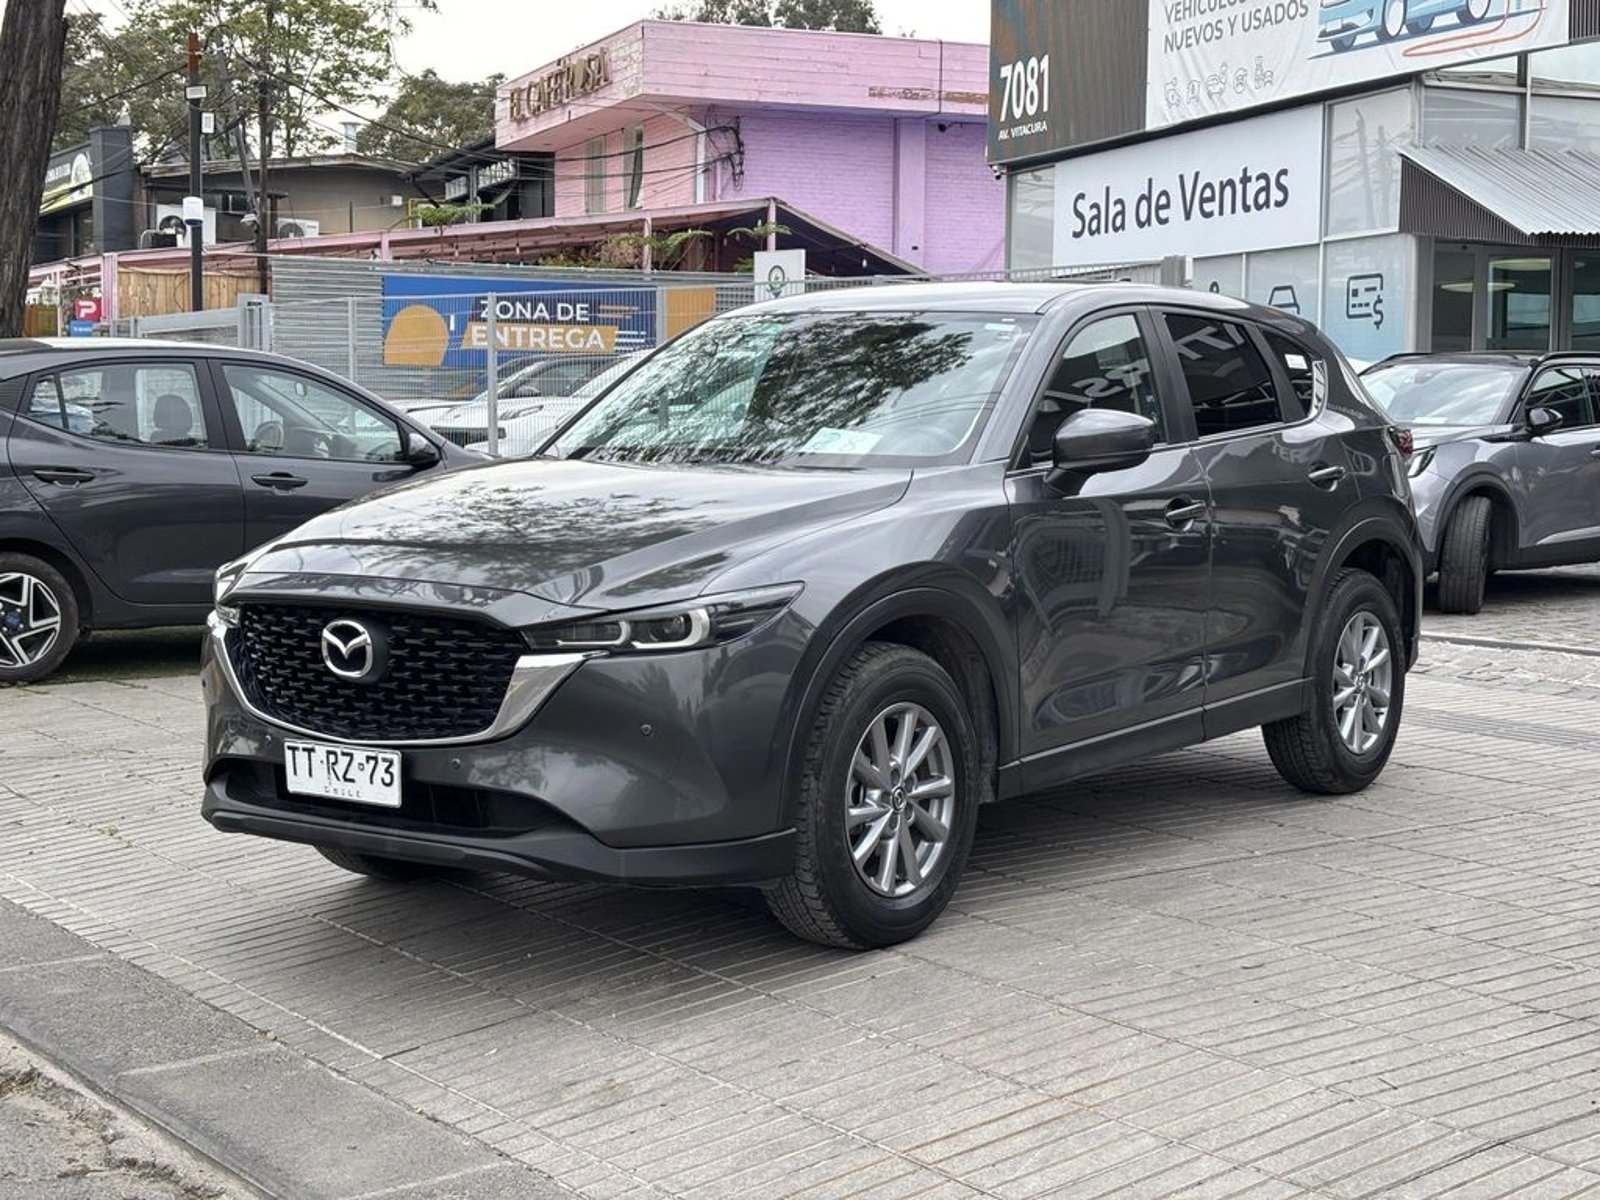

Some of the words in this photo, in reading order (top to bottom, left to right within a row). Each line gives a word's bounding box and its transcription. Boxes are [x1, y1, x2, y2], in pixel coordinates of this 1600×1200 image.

[1165, 0, 1247, 24] VEHICUL
[1164, 20, 1223, 53] NUEVOS
[1228, 14, 1238, 37] Y
[1241, 0, 1309, 32] USADOS
[1000, 54, 1049, 122] 7081
[1010, 120, 1048, 138] VITACURA
[1072, 185, 1126, 239] Sala
[1135, 177, 1171, 230] de
[1178, 166, 1290, 222] Ventas
[556, 302, 590, 321] DE
[471, 325, 605, 350] ENTREGA
